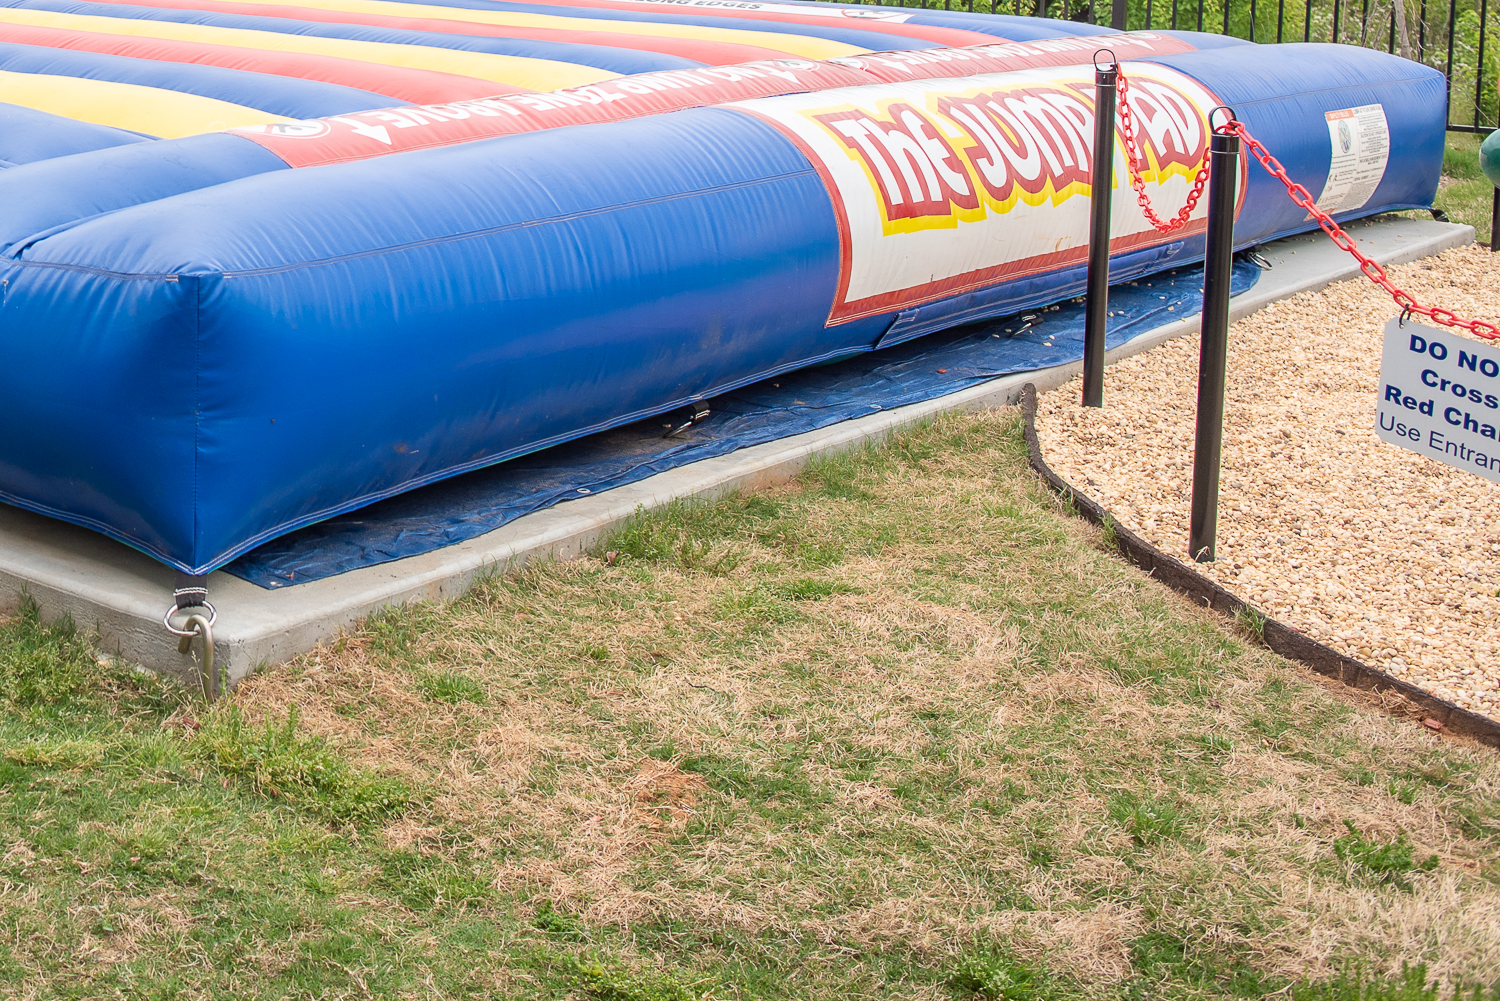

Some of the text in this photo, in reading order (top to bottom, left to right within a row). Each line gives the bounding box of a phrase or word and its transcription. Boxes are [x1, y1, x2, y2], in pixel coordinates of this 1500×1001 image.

[694, 0, 764, 10] EDGES
[365, 94, 522, 129] ABOVE
[1409, 334, 1448, 361] DO
[1421, 369, 1499, 409] Cross
[1379, 412, 1421, 441] Use
[1384, 384, 1500, 442] Red Cha
